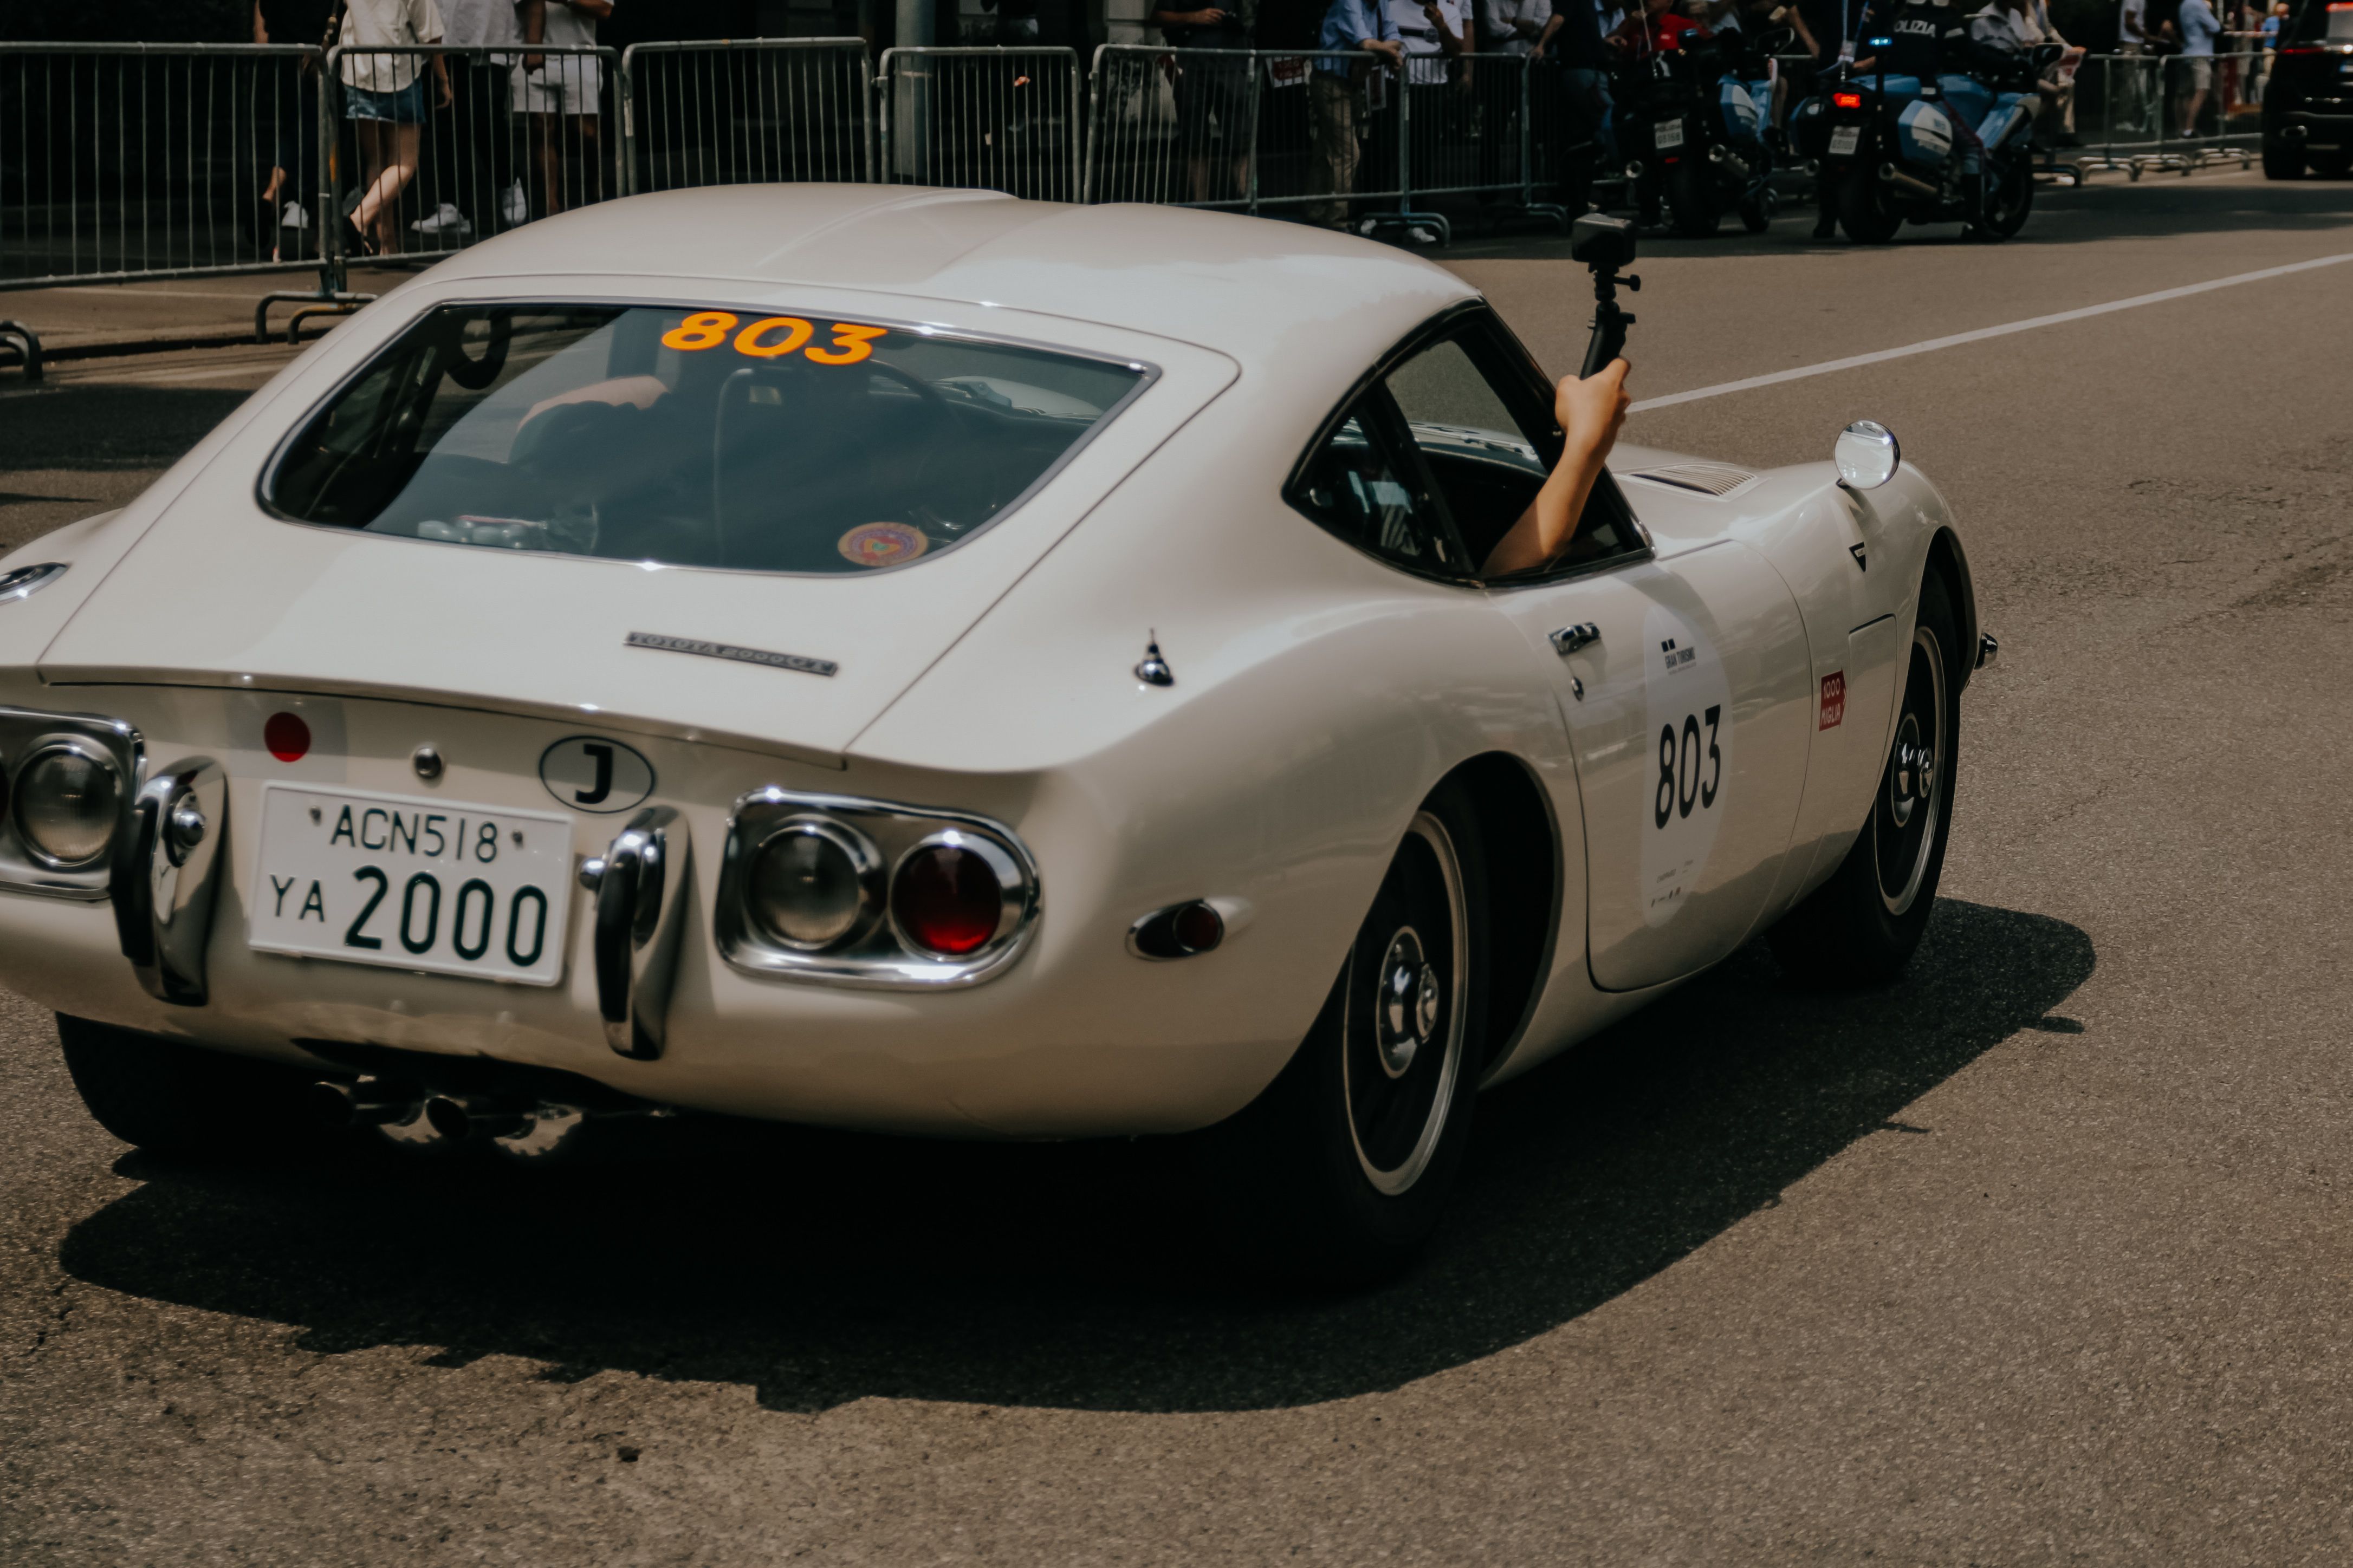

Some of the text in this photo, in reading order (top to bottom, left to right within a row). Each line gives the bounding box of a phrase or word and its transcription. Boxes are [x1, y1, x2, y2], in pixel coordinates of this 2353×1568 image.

[1894, 19, 1936, 38] OLIZIA
[662, 312, 888, 365] 803
[632, 632, 719, 653] TOYOTA
[1820, 703, 1840, 726] MIGLIA
[1824, 678, 1840, 699] 1000
[575, 744, 614, 805] J
[1655, 704, 1721, 829] 803
[330, 804, 498, 863] ACN518
[269, 864, 548, 967] YA 2000
